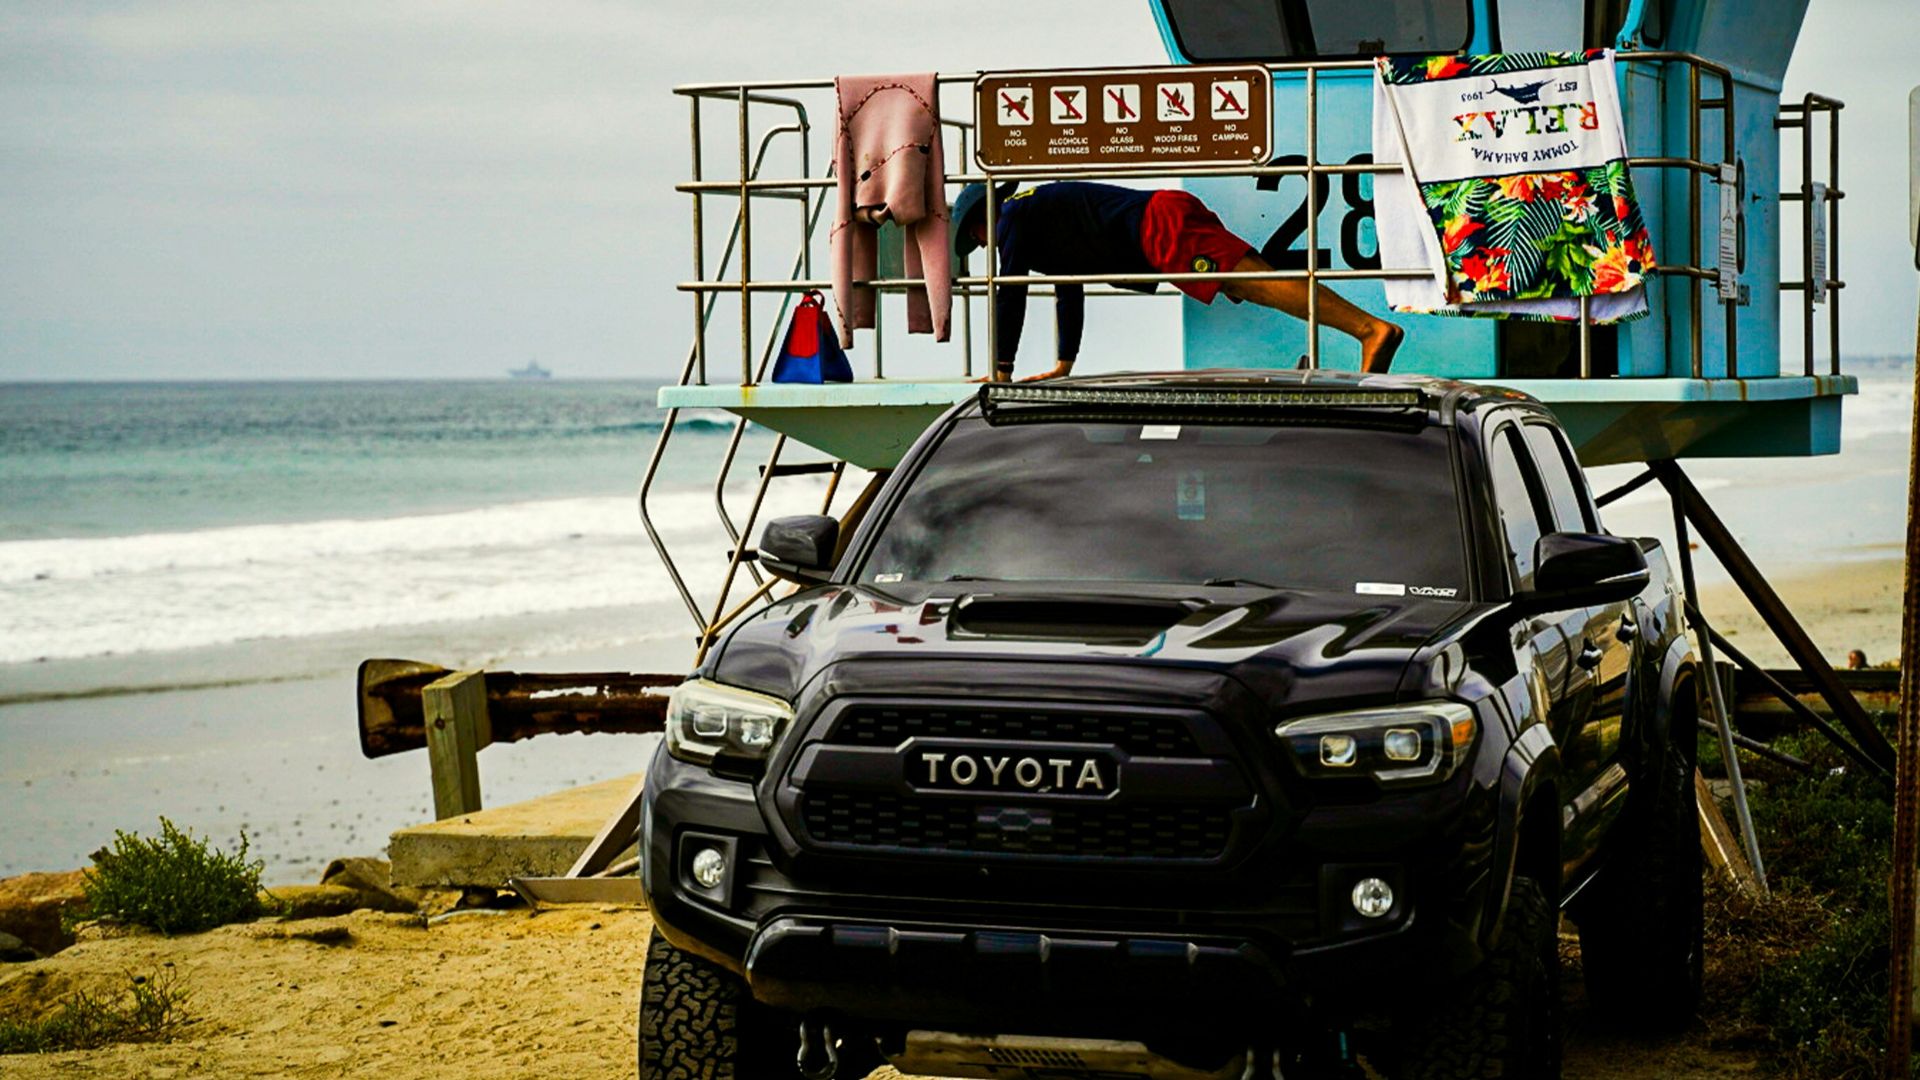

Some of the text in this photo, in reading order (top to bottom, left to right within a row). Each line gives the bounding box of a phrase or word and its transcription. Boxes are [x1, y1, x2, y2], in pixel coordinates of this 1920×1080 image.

[1452, 101, 1600, 144] RELAX
[1063, 128, 1075, 136] NO
[1169, 125, 1182, 133] NO
[1224, 124, 1236, 132] NO
[1009, 129, 1021, 137] NO
[1212, 133, 1249, 142] CAMPING
[1005, 138, 1027, 147] DOGS
[1049, 137, 1089, 145] ALCOHOLIC
[1110, 136, 1134, 144] GLASS
[1154, 134, 1198, 143] WOOD FIRES
[1048, 146, 1090, 155] BEVERAGES
[1100, 145, 1144, 154] CONTAINERS
[1152, 145, 1201, 154] PROPANE ONLY
[1532, 140, 1579, 162] TOMMY
[1255, 153, 1382, 271] 28
[921, 752, 1104, 790] TOYOTA
